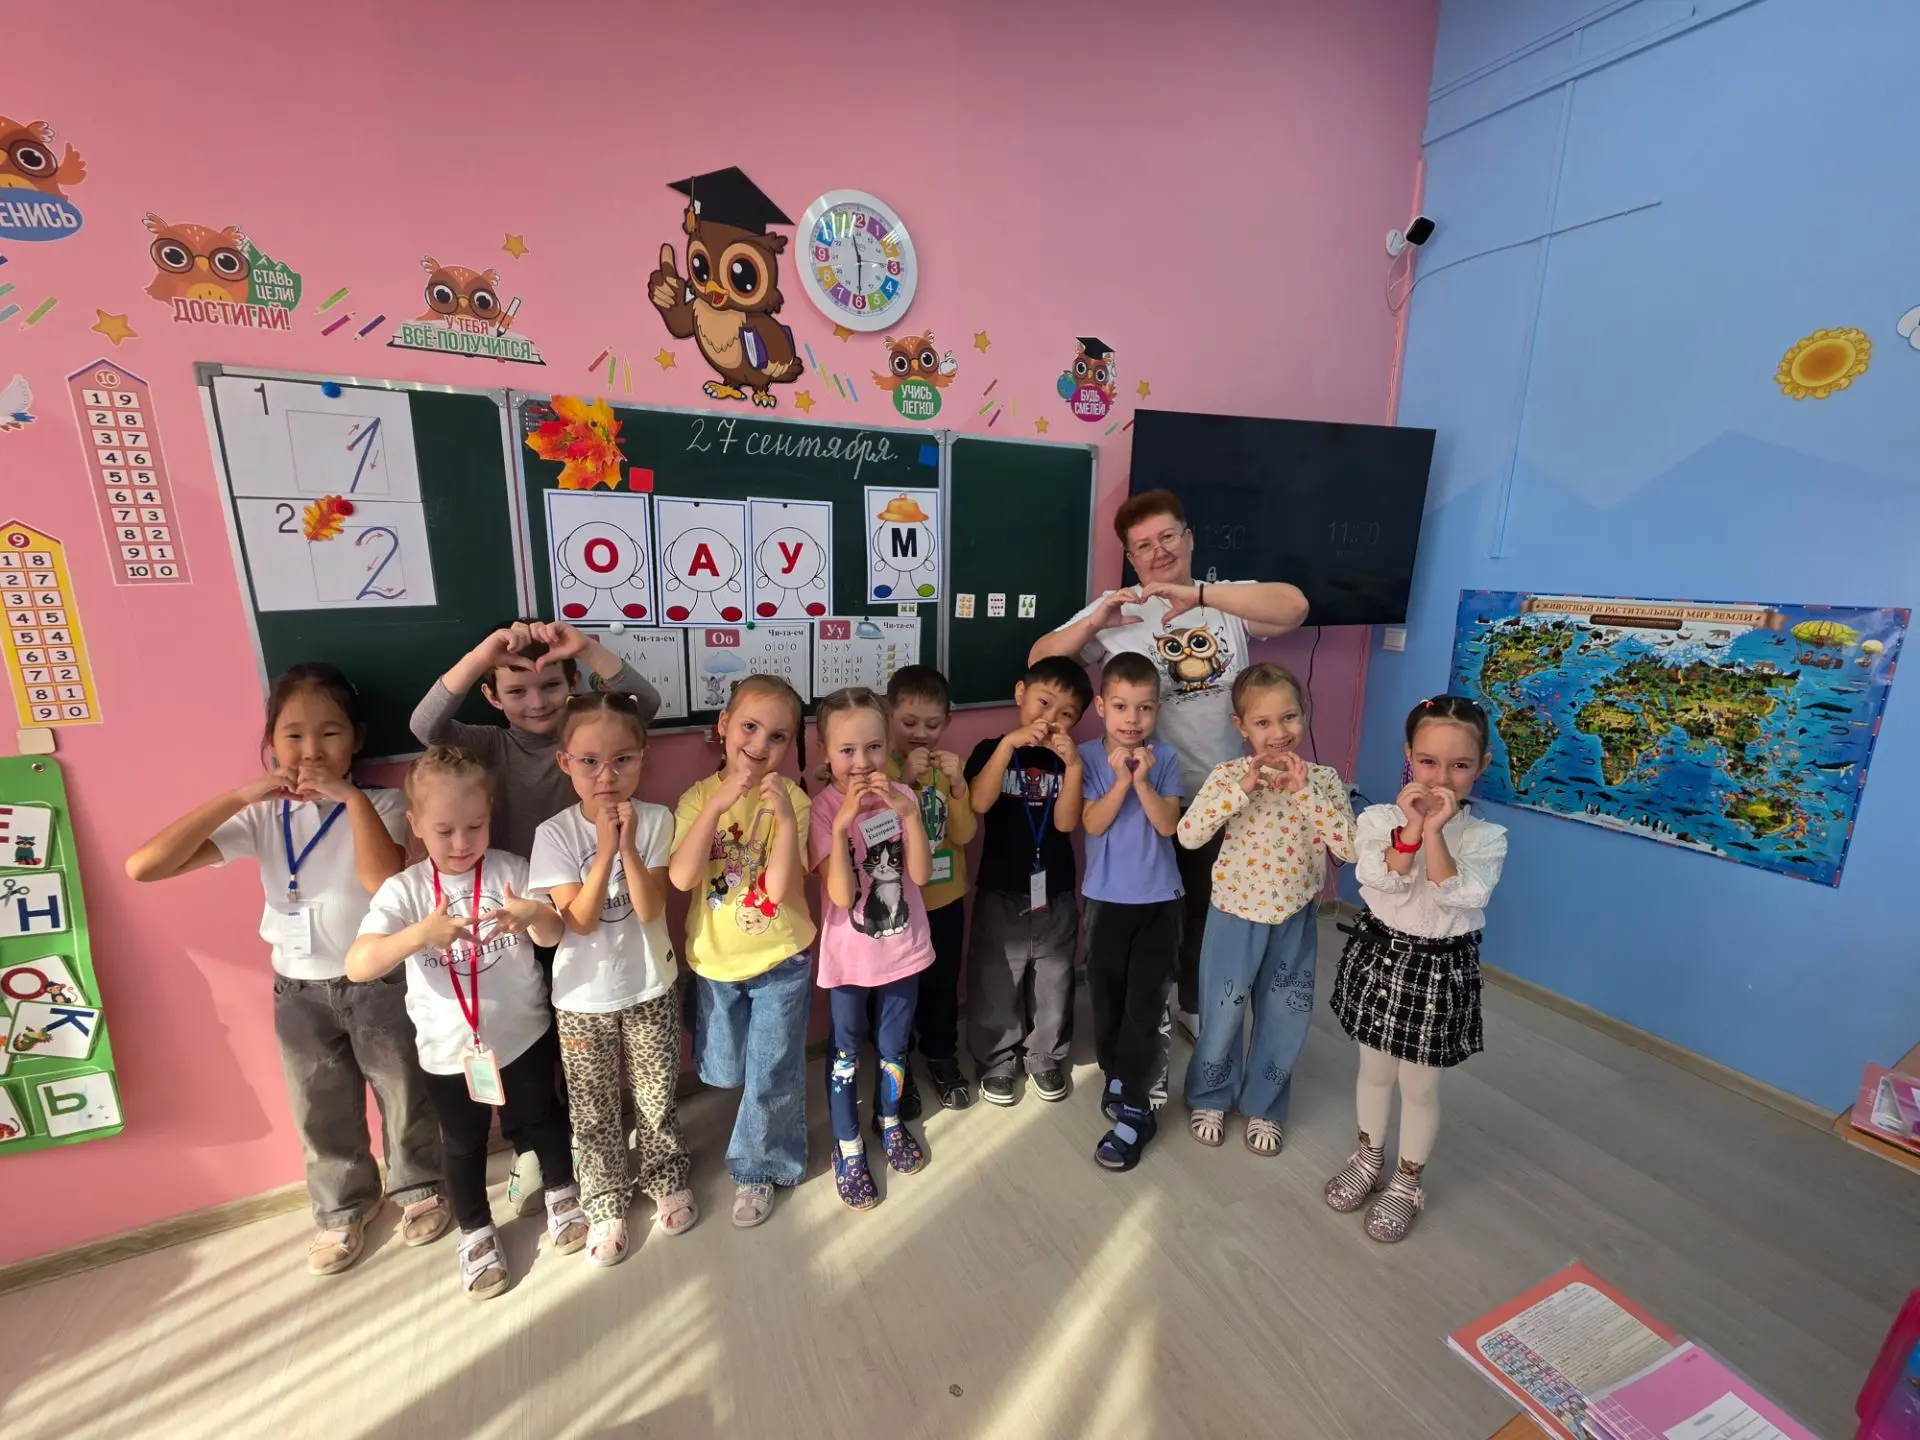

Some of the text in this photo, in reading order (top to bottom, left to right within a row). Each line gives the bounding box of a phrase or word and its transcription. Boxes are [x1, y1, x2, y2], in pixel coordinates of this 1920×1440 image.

[818, 247, 826, 259] 9
[885, 241, 892, 253] 2
[890, 261, 898, 274] 3
[253, 268, 293, 286] СТАВЬ
[255, 284, 295, 303] ЦЕЛИ!
[836, 286, 844, 299] 7
[885, 282, 893, 293] 4
[855, 296, 863, 308] 6
[873, 294, 880, 305] 5
[174, 298, 291, 331] ДОСТИГАЙ!
[445, 315, 489, 335] У ТЕБЯ
[402, 326, 532, 359] ВСЁ ПОЛУЧИТСЯ
[99, 374, 118, 384] 10
[900, 384, 932, 400] УЧИСЬ
[1080, 389, 1100, 402] БУДЬ
[92, 394, 131, 405] 1 9
[254, 383, 269, 415] 1
[901, 399, 934, 416] ЛЕГКО!
[96, 413, 136, 425] 2 8
[101, 433, 140, 444] 3 7
[106, 453, 145, 464] 4 6
[347, 417, 381, 493] 1
[110, 472, 150, 483] 5 5
[115, 492, 154, 502] 6 4
[118, 511, 158, 520] 7 3
[276, 503, 298, 533] 2
[15, 535, 24, 546] 9
[125, 530, 163, 539] 8 2
[891, 528, 918, 558] М
[128, 548, 166, 558] 9 1
[583, 537, 619, 573] О
[778, 541, 804, 573] У
[3, 556, 44, 565] 1 8
[355, 526, 407, 600] 2
[688, 543, 720, 577] А
[129, 566, 172, 576] 10 0
[7, 575, 48, 585] 2 7
[12, 594, 54, 604] 3 6
[17, 613, 58, 623] 4 5
[1542, 602, 1594, 613] ЖИВОТНЫЙ
[1605, 606, 1684, 618] РАСТИТЕЛЬНЫЙ
[1686, 610, 1711, 620] МИР
[1713, 612, 1753, 622] ЗЕМЛИ
[21, 632, 63, 643] 5 4
[826, 624, 844, 639] Уу
[633, 634, 675, 642] Чи-та-ем
[712, 632, 733, 645] Оо
[27, 651, 67, 662] 6 3
[30, 670, 72, 681] 7 2
[36, 688, 75, 699] 8 1
[40, 707, 81, 718] 9 0
